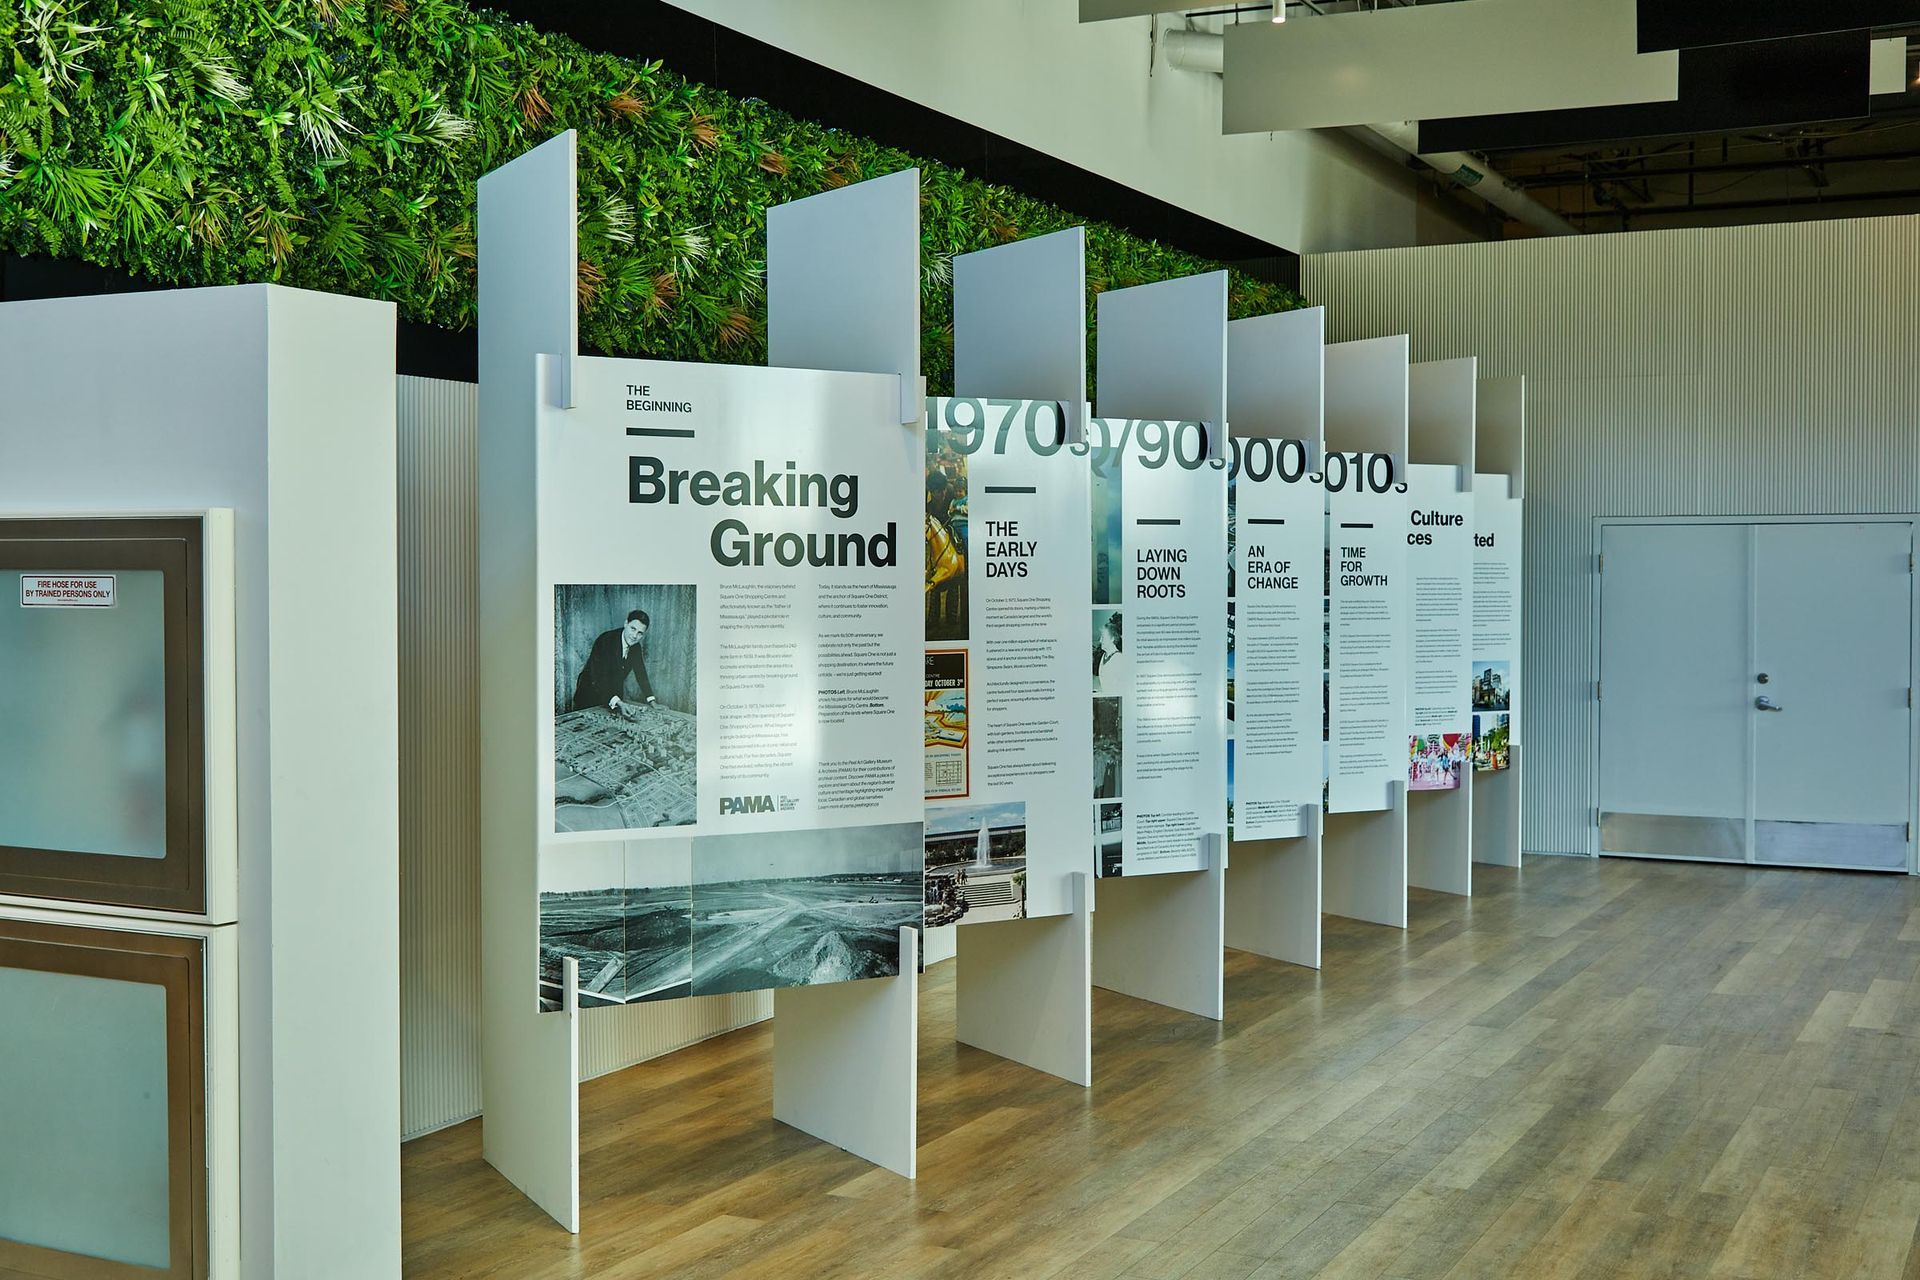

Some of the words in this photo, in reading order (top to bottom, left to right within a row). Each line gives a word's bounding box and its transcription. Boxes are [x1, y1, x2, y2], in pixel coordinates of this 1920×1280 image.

[626, 385, 650, 396] THE
[626, 400, 691, 412] BEGINNING
[628, 456, 858, 518] Breaking
[1411, 510, 1463, 526] Culture
[986, 522, 1018, 536] THE
[710, 519, 896, 567] Ground
[986, 542, 1037, 557] EARLY
[1137, 549, 1187, 563] LAYING
[1248, 546, 1264, 557] AN
[1341, 547, 1366, 558] TIME
[986, 562, 1028, 577] DAYS
[1248, 562, 1271, 573] ERA
[1274, 562, 1290, 573] OF
[1341, 561, 1362, 572] FOR
[1137, 567, 1180, 580] DOWN
[1248, 577, 1298, 589] CHANGE
[1341, 575, 1387, 586] GROWTH
[1137, 585, 1186, 598] ROOTS
[720, 795, 775, 815] PAMA
